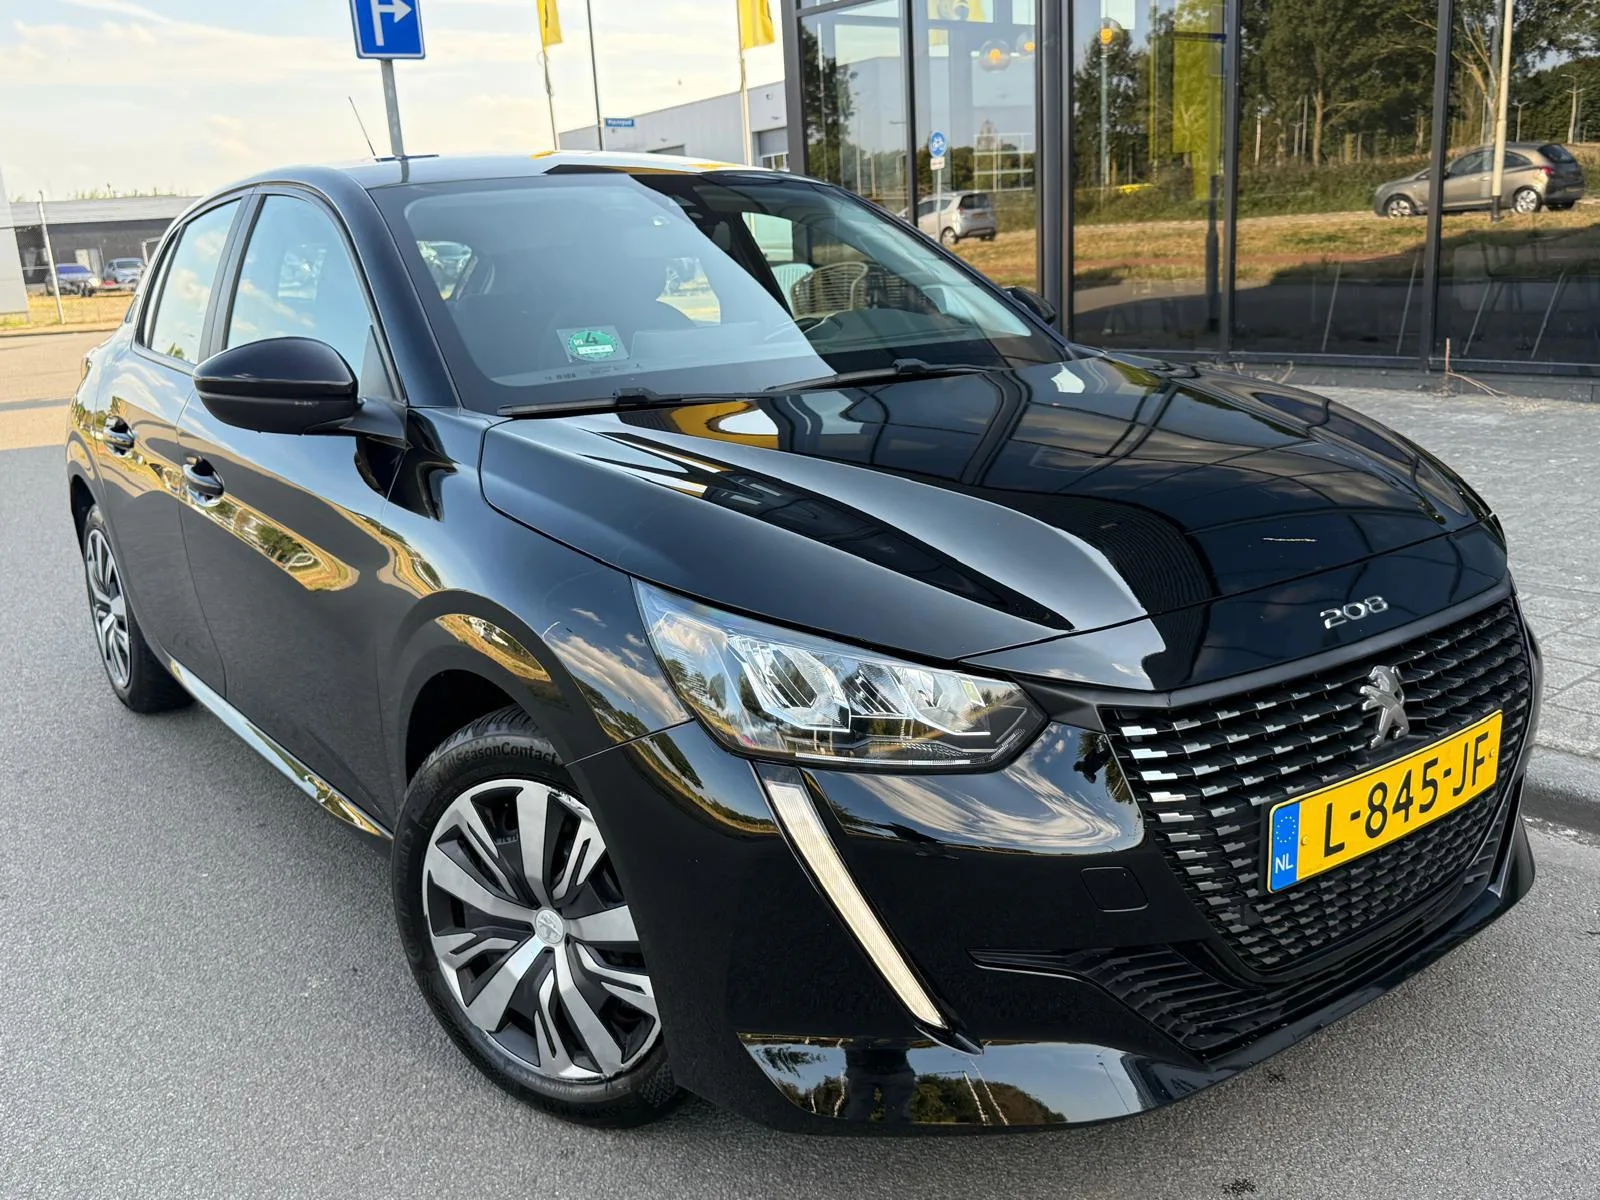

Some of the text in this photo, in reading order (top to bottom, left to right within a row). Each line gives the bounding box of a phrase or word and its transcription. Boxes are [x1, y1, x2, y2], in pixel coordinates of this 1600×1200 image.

[585, 332, 598, 344] 4
[1319, 595, 1389, 630] 208
[1323, 731, 1489, 858] L-845-JF
[1274, 852, 1294, 874] NL
